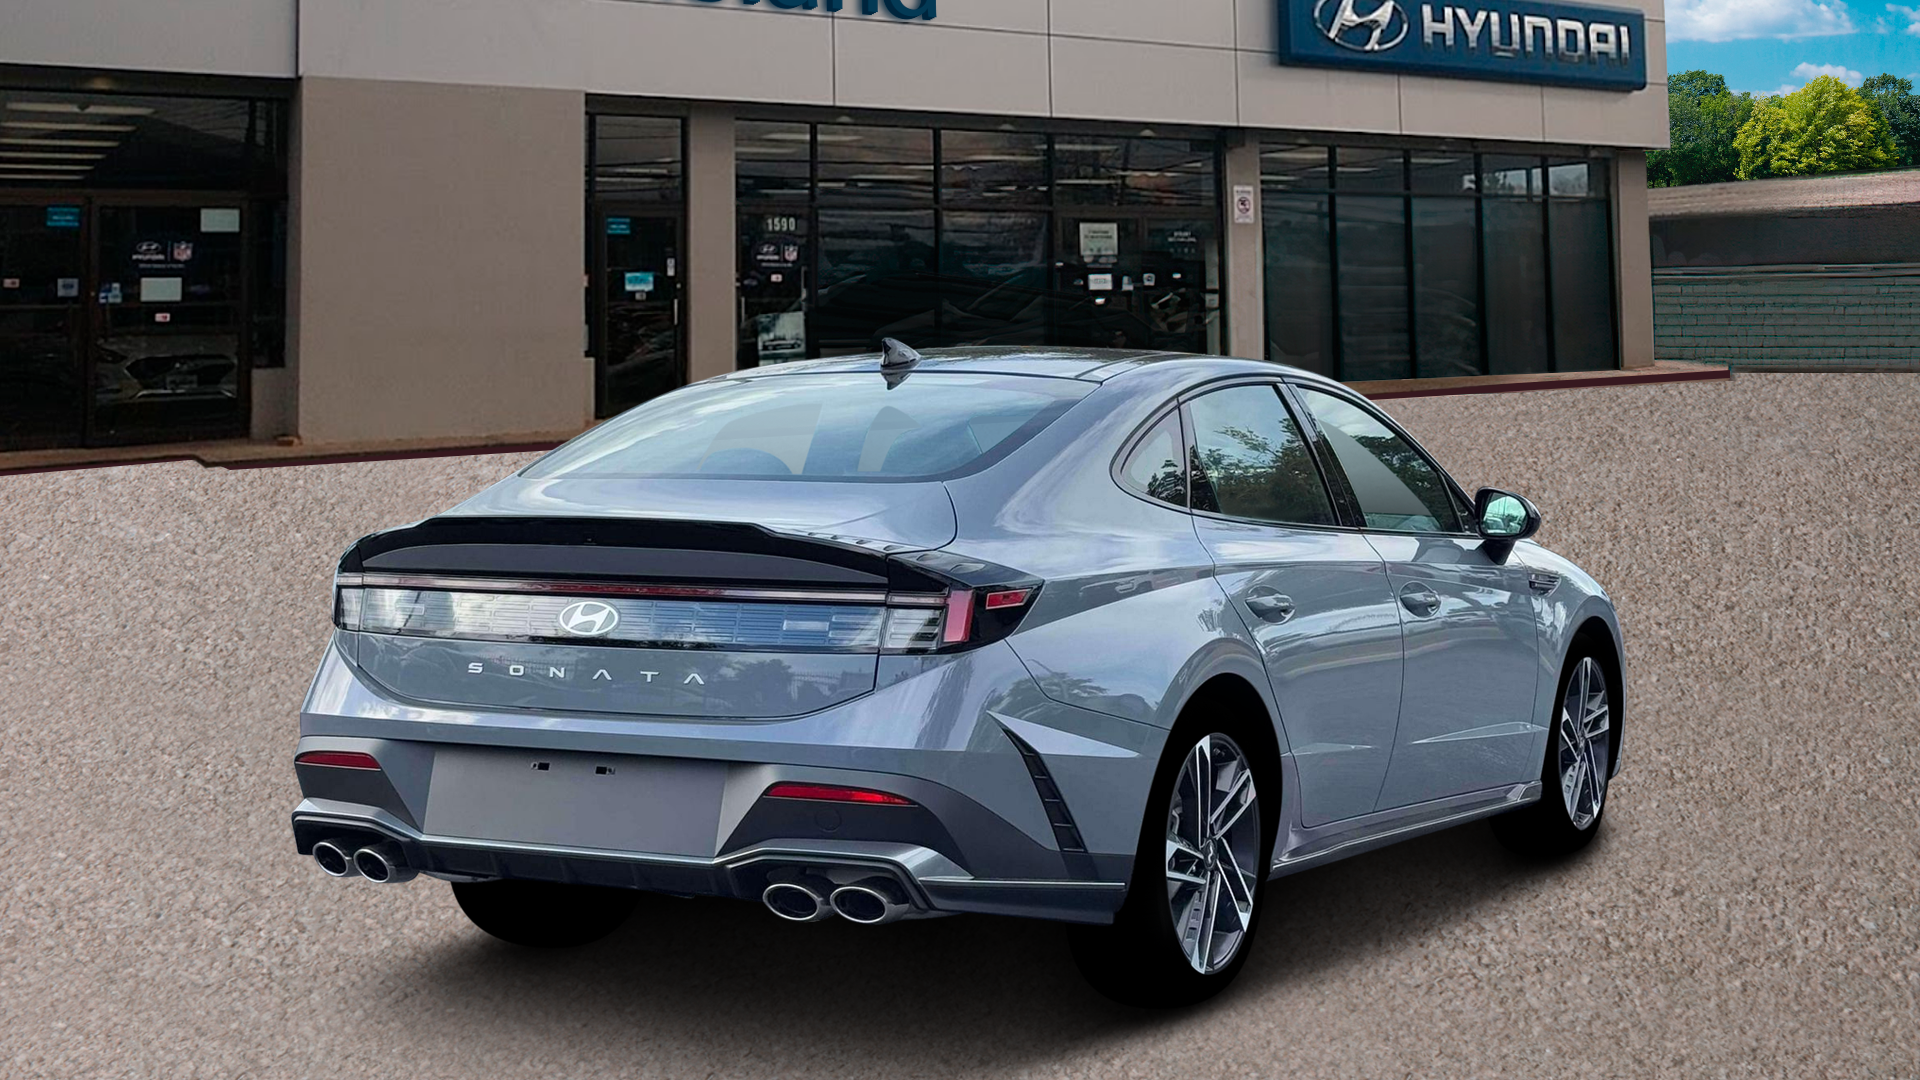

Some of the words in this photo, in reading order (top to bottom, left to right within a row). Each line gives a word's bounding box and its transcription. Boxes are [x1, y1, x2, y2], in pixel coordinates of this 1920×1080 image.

[1421, 4, 1632, 64] HYUNDAI
[767, 217, 796, 232] 1590
[467, 661, 705, 685] SONATA
